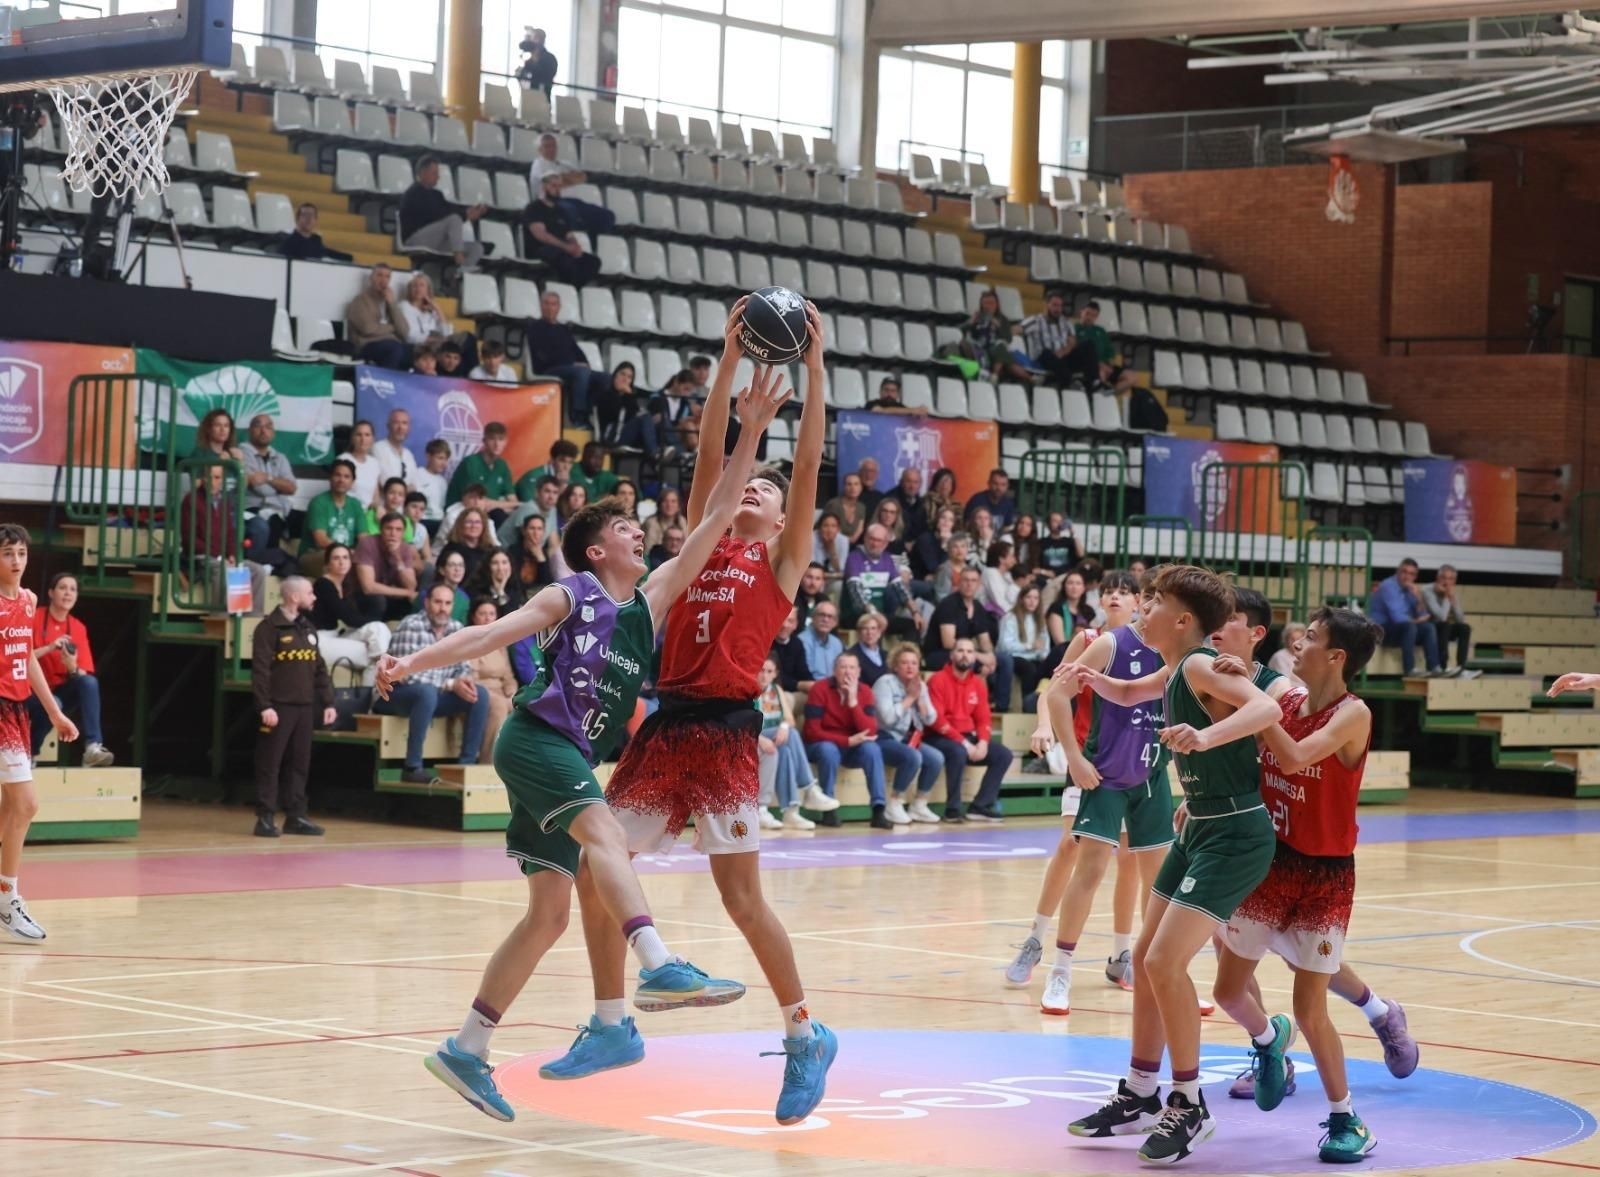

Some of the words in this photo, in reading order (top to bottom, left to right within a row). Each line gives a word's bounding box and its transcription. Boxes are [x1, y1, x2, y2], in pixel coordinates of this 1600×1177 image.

[695, 609, 711, 644] 3
[599, 644, 640, 676] Unicaja
[581, 708, 609, 740] 45
[1140, 743, 1160, 768] 47
[1271, 799, 1290, 837] 21
